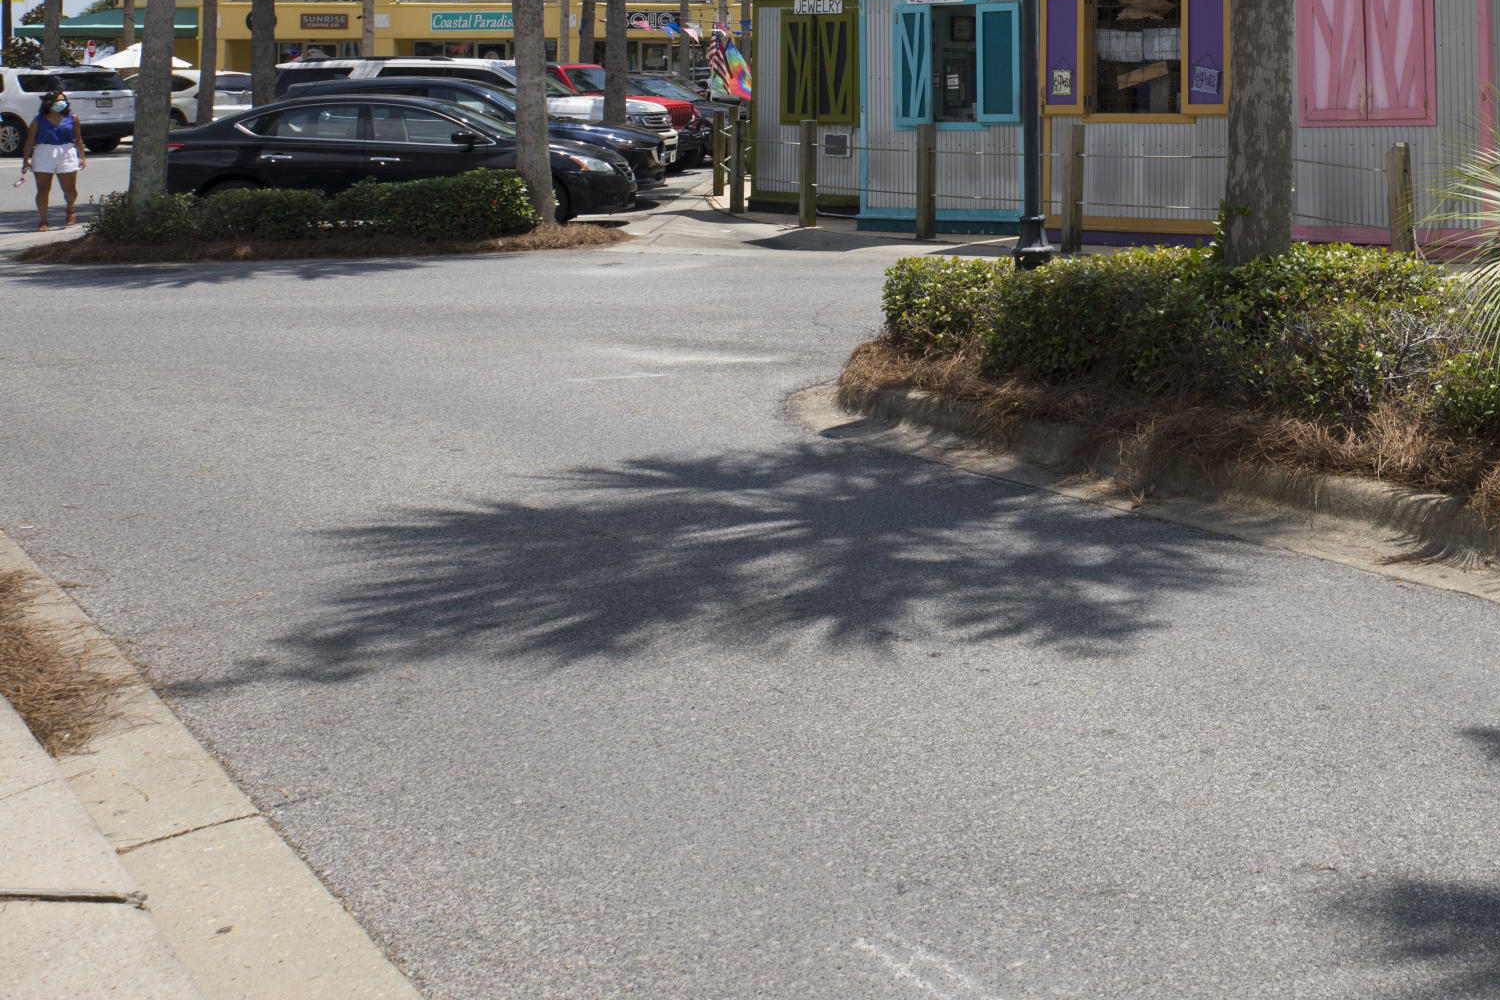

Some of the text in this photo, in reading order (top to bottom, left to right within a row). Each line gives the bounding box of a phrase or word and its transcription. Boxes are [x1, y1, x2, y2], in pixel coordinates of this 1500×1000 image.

[795, 0, 842, 13] JEWELRY
[303, 15, 346, 23] SUNRISE
[432, 14, 473, 28] Coastal
